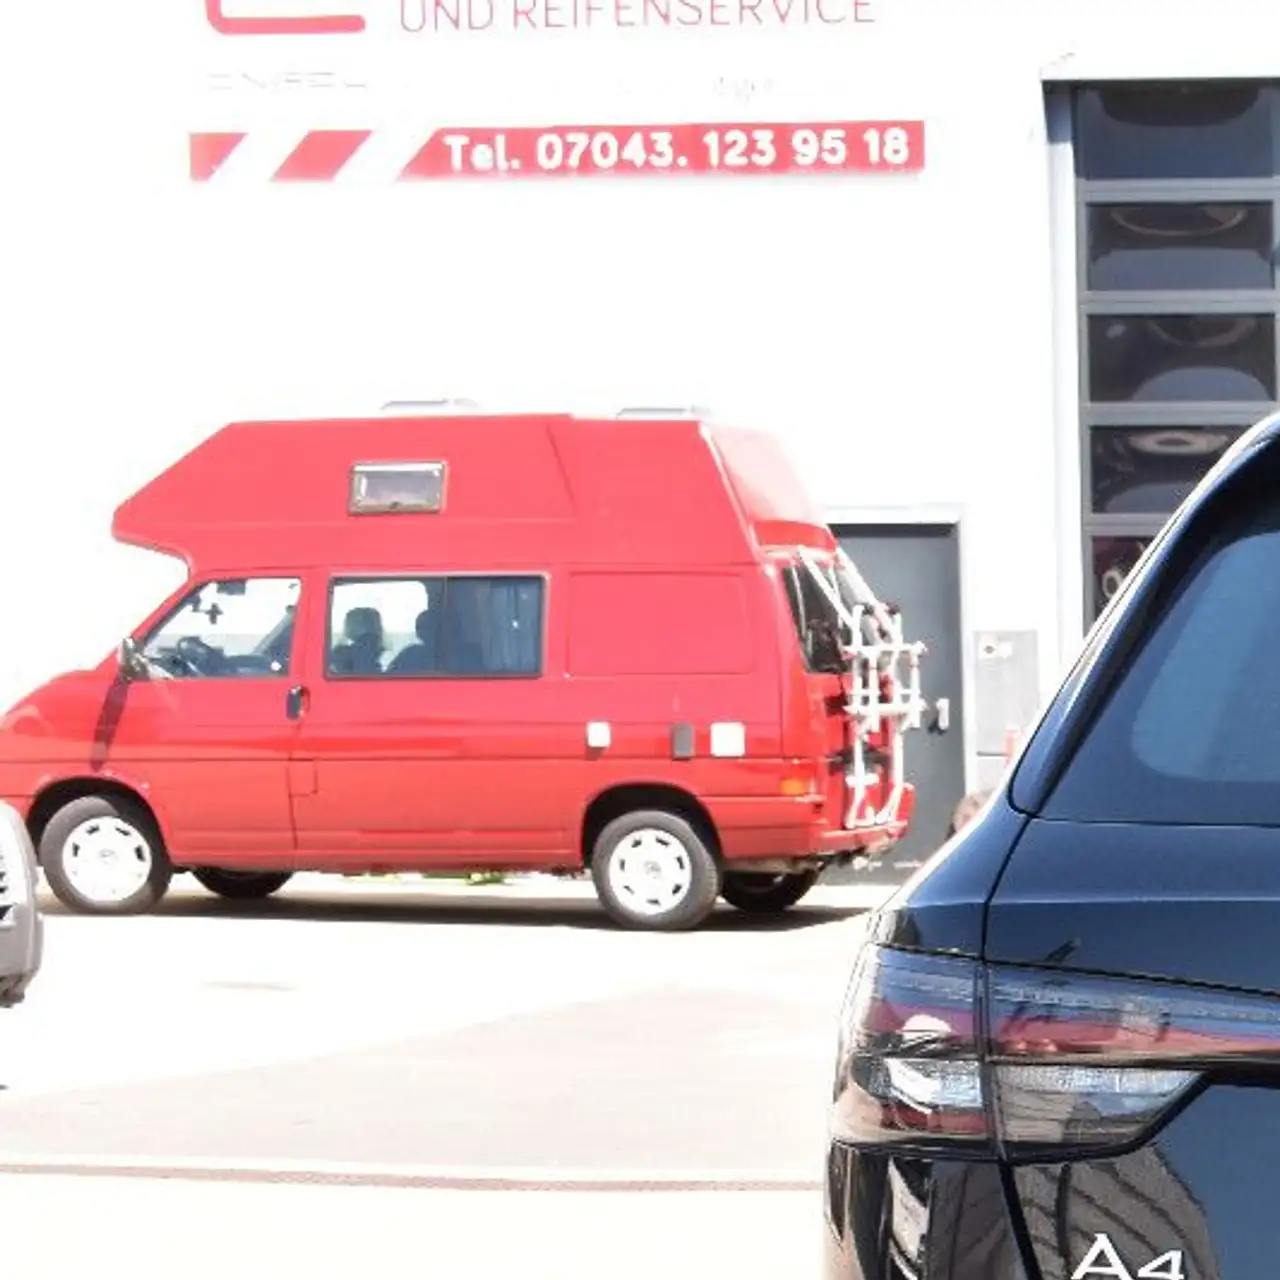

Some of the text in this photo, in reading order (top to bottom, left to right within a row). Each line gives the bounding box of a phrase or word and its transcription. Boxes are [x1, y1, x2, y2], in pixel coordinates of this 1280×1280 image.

[400, 0, 876, 32] UND REIFENSERVICE
[444, 127, 909, 171] Tel. 07043. 123 95 18
